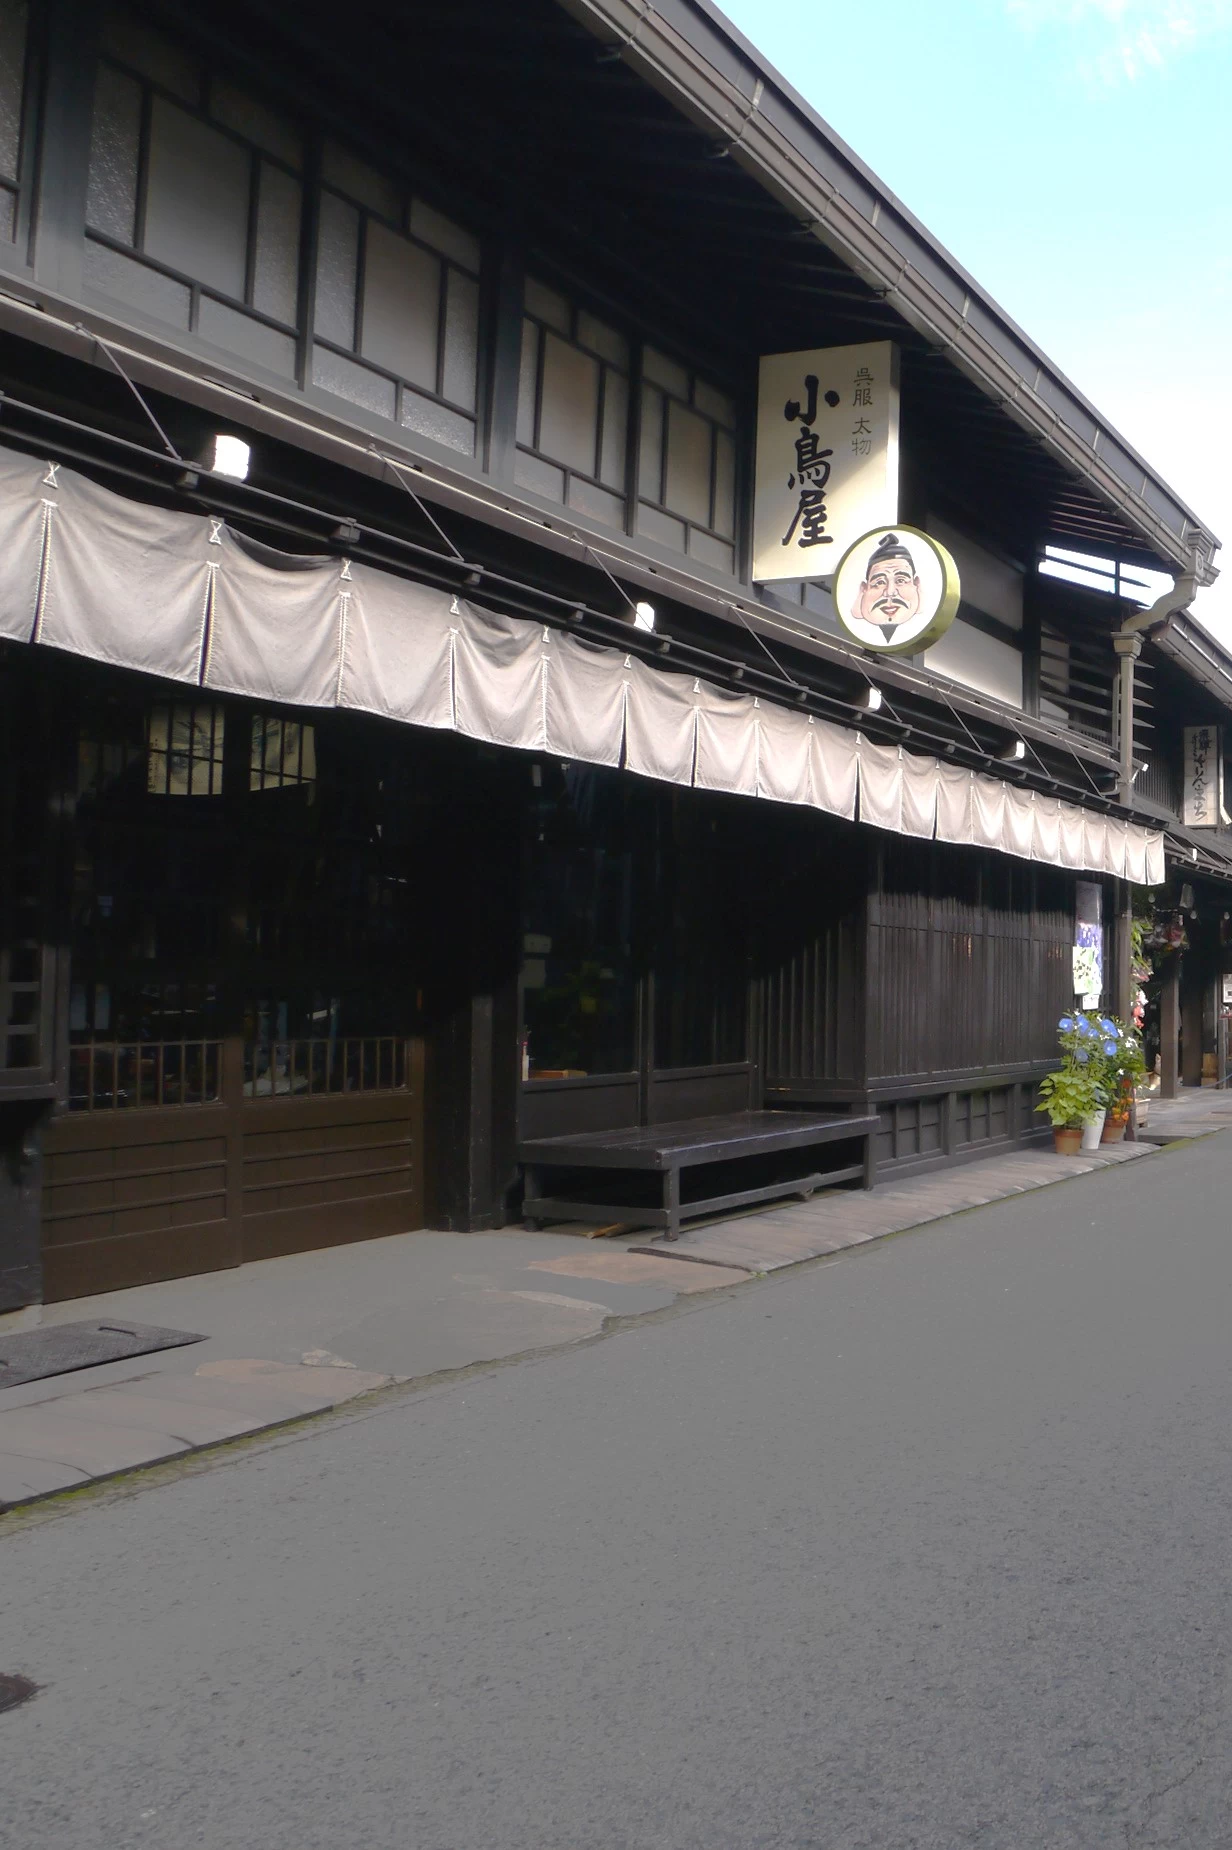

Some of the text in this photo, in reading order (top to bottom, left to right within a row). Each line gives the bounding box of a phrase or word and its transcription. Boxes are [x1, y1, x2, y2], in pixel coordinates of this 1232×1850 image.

[781, 374, 840, 549] 小鳥屋
[851, 367, 874, 456] 呉服 太物
